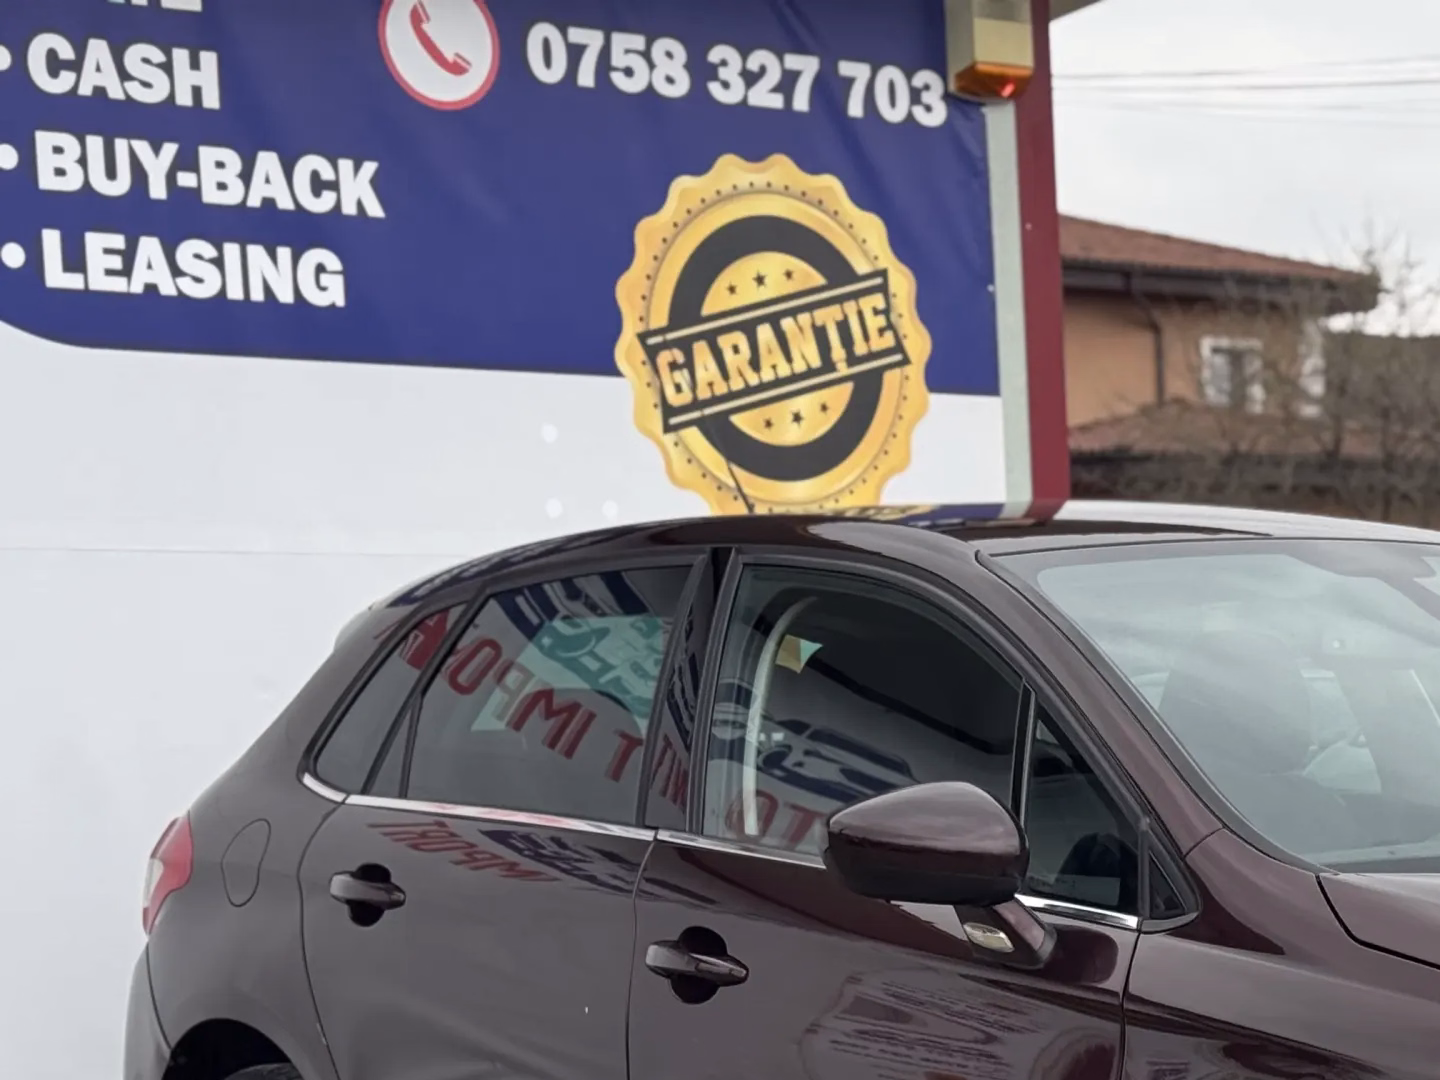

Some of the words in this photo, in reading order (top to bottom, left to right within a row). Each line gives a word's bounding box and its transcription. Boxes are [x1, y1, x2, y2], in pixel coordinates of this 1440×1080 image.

[27, 32, 220, 109] CASH
[527, 21, 691, 98] 0758
[706, 43, 820, 112] 327
[837, 59, 948, 127] 703
[34, 130, 386, 218] BUY-BACK
[41, 228, 346, 308] LEASING
[656, 293, 896, 408] GARANȚIE
